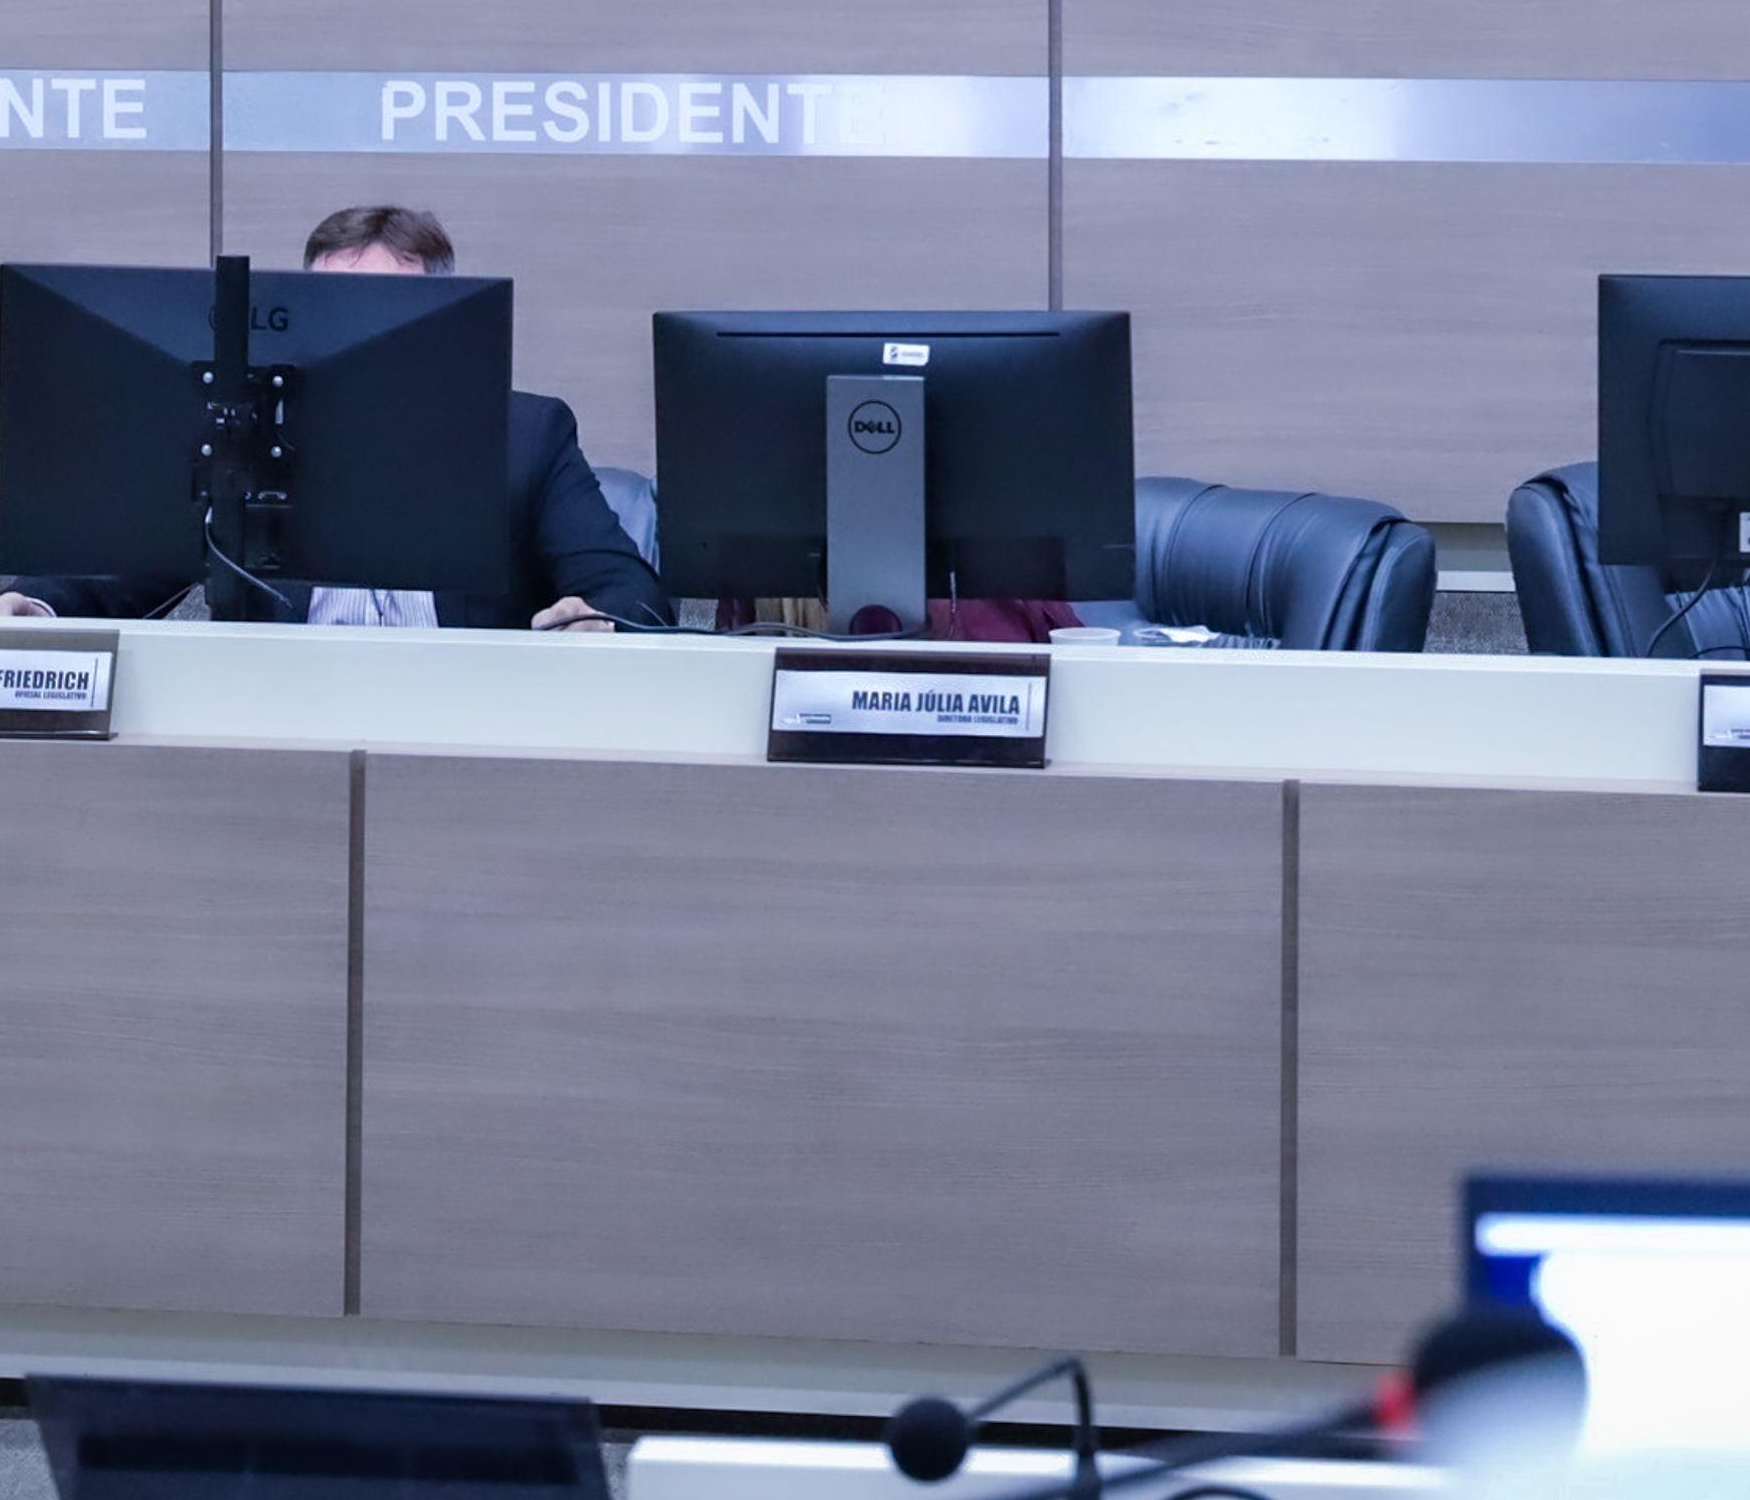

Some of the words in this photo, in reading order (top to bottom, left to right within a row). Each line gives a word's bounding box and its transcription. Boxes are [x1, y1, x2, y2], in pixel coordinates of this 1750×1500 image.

[251, 306, 290, 331] LG
[854, 419, 895, 434] DELL
[852, 690, 911, 712] MARIA
[915, 689, 964, 713] JÚLIA
[967, 693, 1020, 715] AVILA
